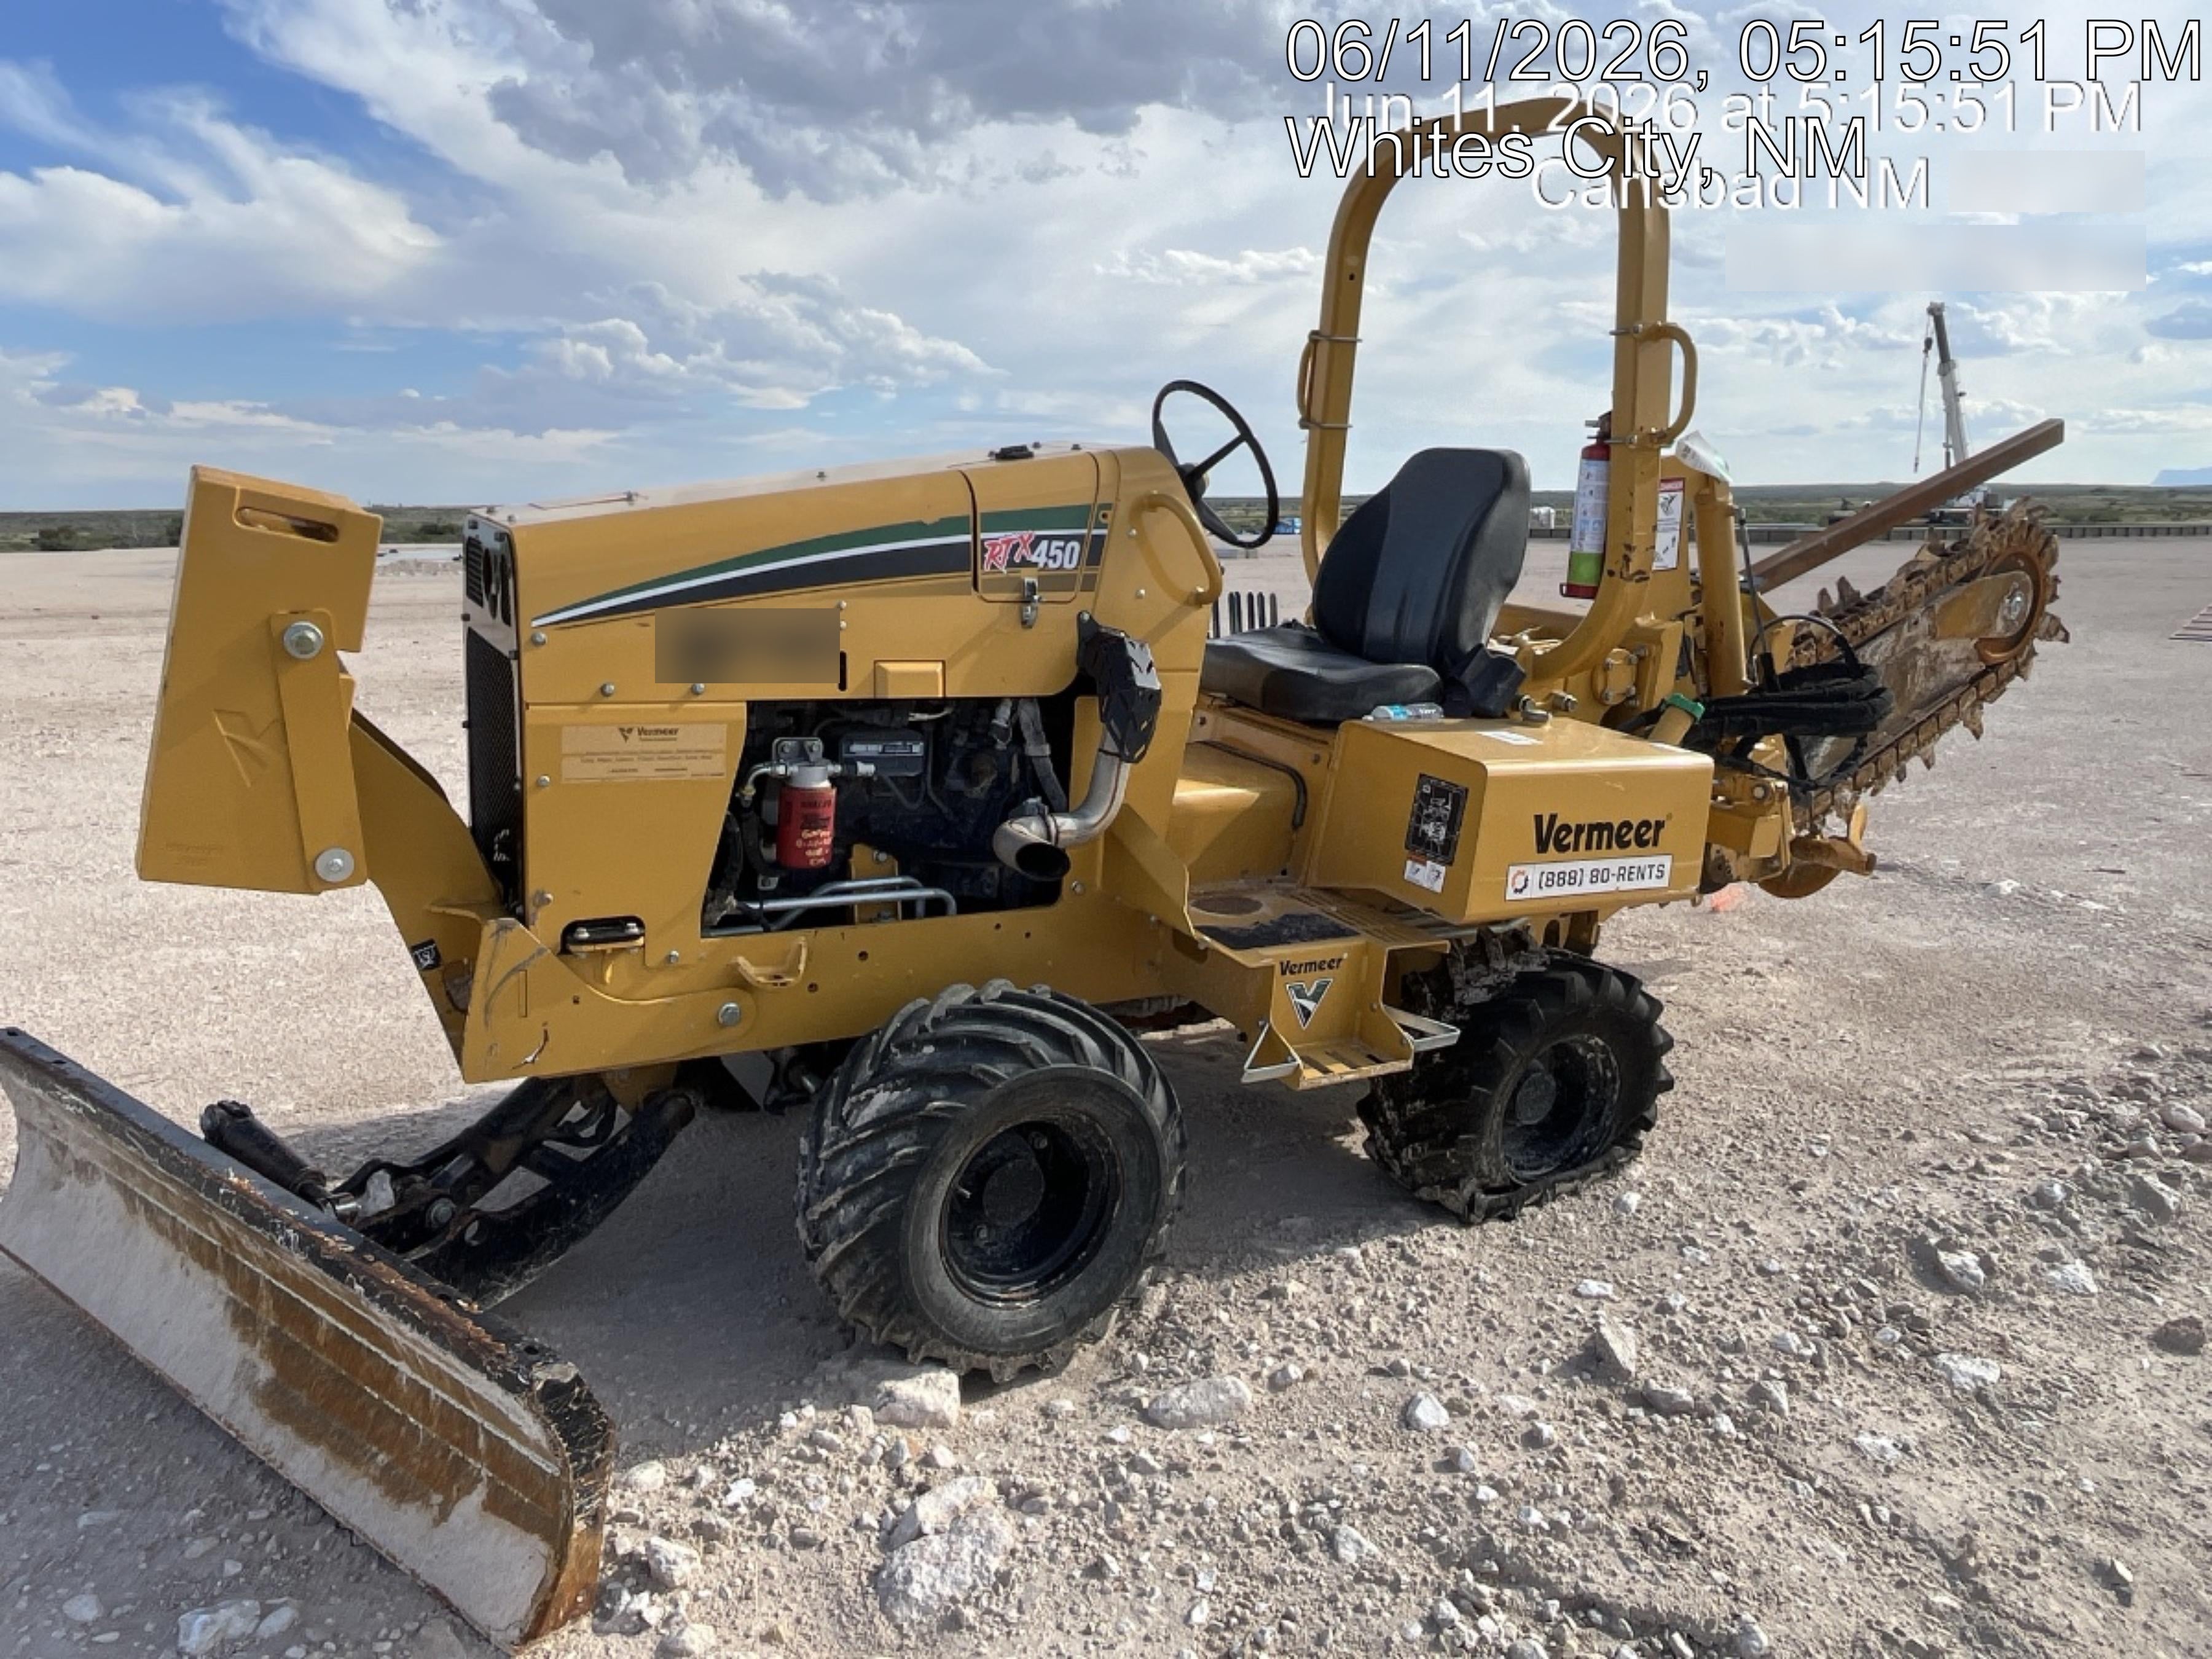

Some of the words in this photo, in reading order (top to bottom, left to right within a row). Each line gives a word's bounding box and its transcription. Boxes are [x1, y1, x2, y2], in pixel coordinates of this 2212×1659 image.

[1029, 539, 1081, 570] 450
[638, 727, 679, 736] Vermeer
[1534, 813, 1666, 854] Vermeer
[1539, 868, 1584, 890] (888)
[1590, 864, 1666, 885] 80-RENTS
[1279, 958, 1343, 975] Vermeer
